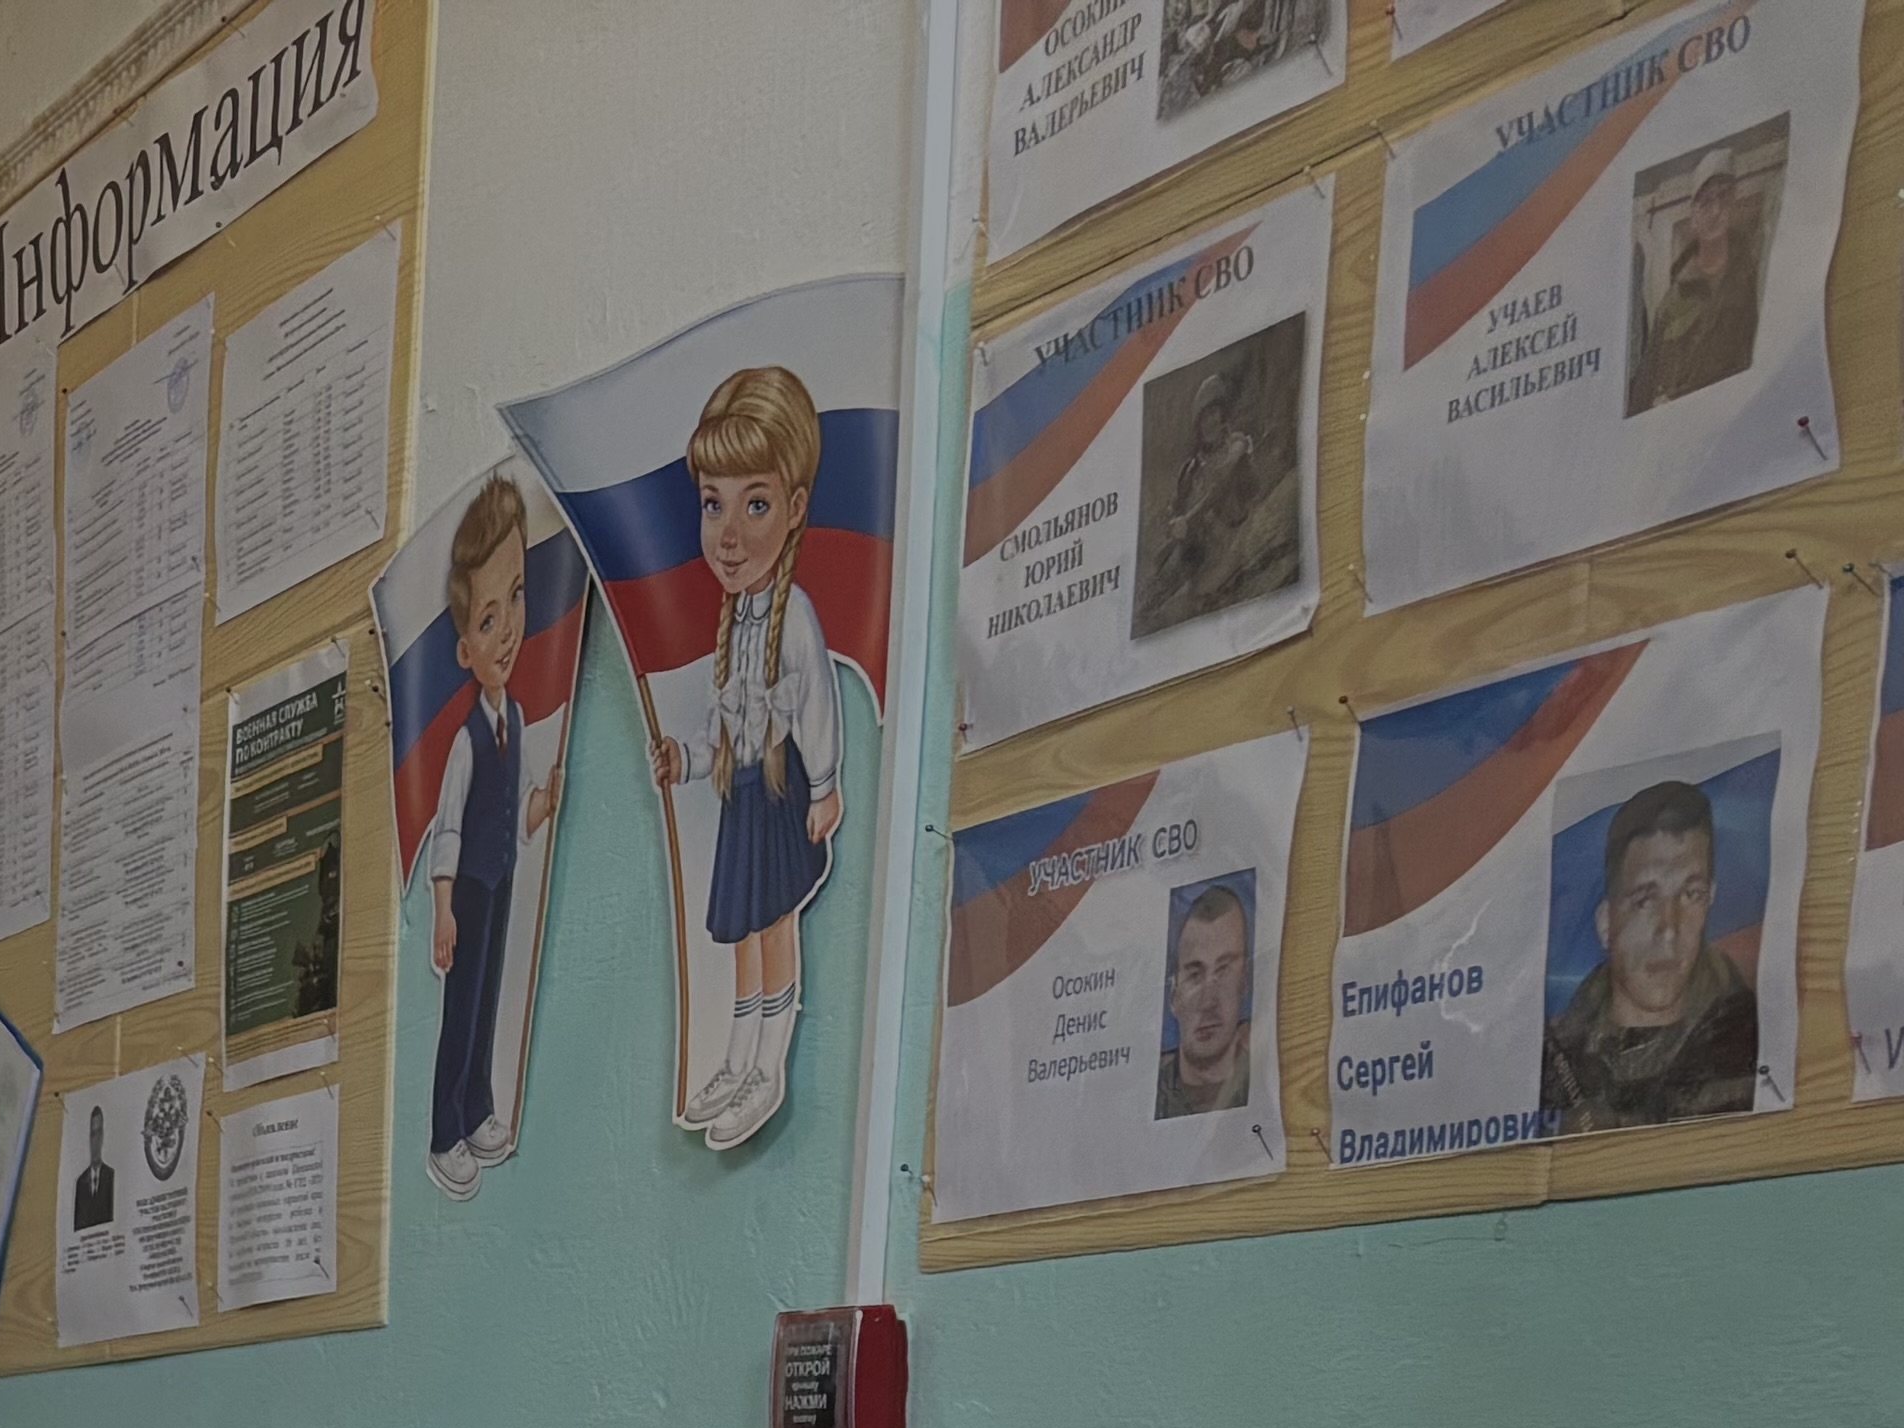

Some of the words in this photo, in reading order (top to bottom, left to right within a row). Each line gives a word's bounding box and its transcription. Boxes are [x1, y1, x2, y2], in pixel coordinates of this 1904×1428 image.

[1019, 12, 1142, 112] АЛЕКСАНДР
[1495, 48, 1670, 157] УЧАСТНИК
[1677, 16, 1752, 73] СВО
[1013, 50, 1147, 157] ВАЛЕРЬЕВИЧ
[1034, 277, 1188, 376] УЧАСТНИК
[1194, 246, 1255, 300] СВО
[1486, 283, 1562, 334] УЧАЕВ
[1466, 312, 1579, 380] АЛЕКСЕЙ
[1446, 348, 1602, 424] ВАСИЛЬЕВИЧ
[999, 491, 1120, 562] СМОЛЬЯНОВ
[1024, 537, 1084, 588] ЮРИЙ
[987, 565, 1121, 640] НИКОЛАЕВИЧ
[278, 692, 318, 723] СЛУЖБА
[1028, 832, 1143, 896] УЧАСТНИК
[1152, 818, 1199, 859] СВО
[1052, 967, 1116, 1000] Осокин
[1341, 965, 1484, 1018] Епифанов
[1052, 1009, 1108, 1045] Денис
[1027, 1046, 1132, 1083] Валерьевич
[1336, 1040, 1434, 1096] Сергей
[1339, 1107, 1562, 1165] Владимирович
[784, 1357, 831, 1377] ОТКРОЙ
